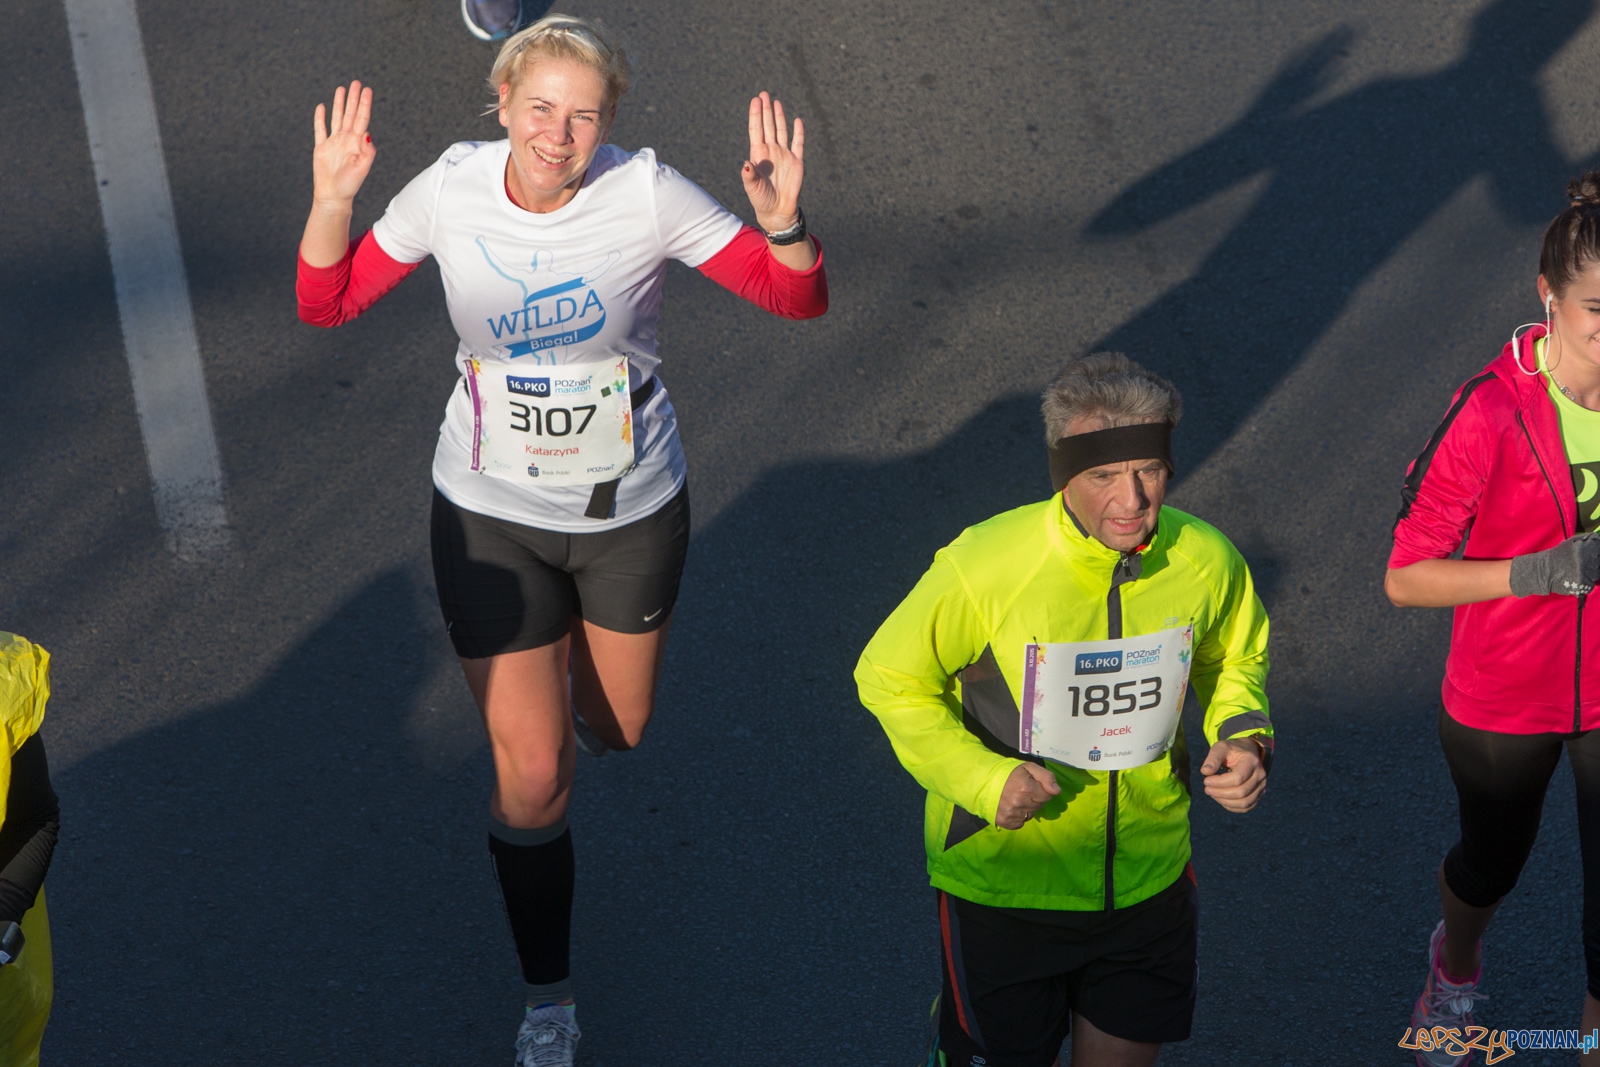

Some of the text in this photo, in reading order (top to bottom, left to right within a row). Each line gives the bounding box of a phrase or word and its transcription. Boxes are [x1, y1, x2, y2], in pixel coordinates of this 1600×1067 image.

[487, 289, 605, 339] WILDA
[530, 331, 578, 350] Biega!
[554, 384, 592, 394] maraton
[509, 400, 597, 437] 3107
[525, 444, 580, 457] Katarzyna
[1096, 657, 1119, 668] PKO
[1126, 655, 1160, 667] maraton
[1067, 676, 1162, 717] 1853
[1100, 725, 1132, 737] Jacek
